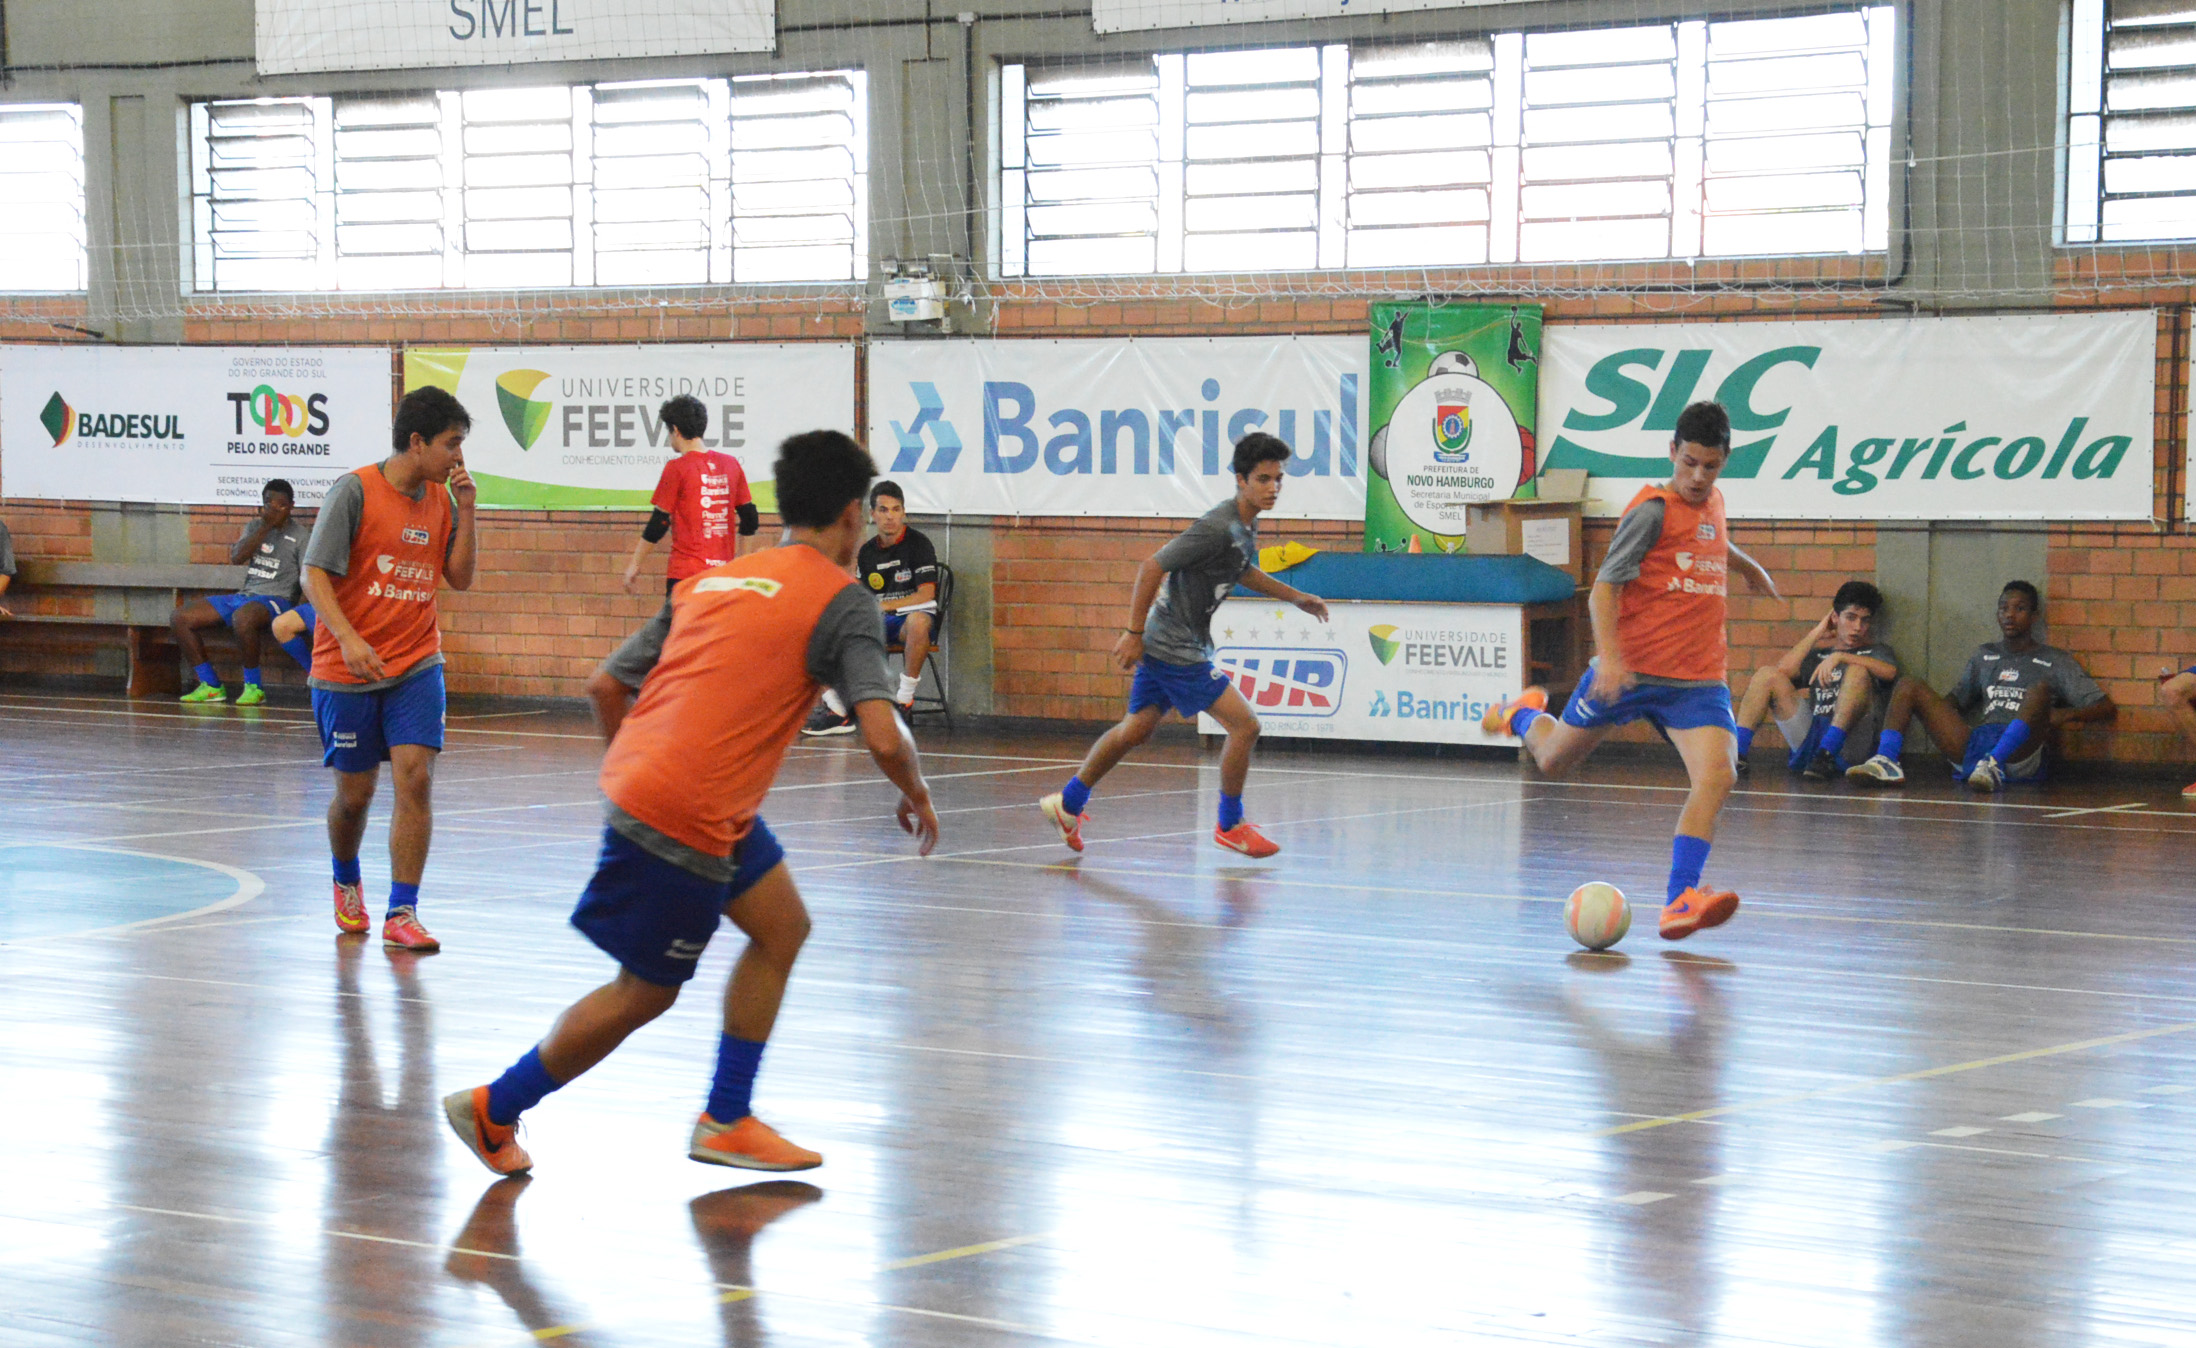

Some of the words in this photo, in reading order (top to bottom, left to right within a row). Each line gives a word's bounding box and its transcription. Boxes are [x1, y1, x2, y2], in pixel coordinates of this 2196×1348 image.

[450, 0, 574, 40] SMEL
[232, 357, 273, 367] GOVERNO
[275, 357, 288, 367] DO
[290, 357, 323, 367] ESTADO
[228, 368, 241, 378] DO
[243, 368, 257, 378] RIO
[259, 368, 294, 378] GRANDE
[296, 369, 309, 378] DO
[311, 369, 327, 379] SUL
[562, 377, 746, 398] UNIVERSIDADE
[1562, 345, 1822, 431] SLC
[227, 384, 330, 438] TODOS
[78, 413, 185, 439] BADESUL
[562, 404, 746, 448] FEEVE
[77, 441, 185, 451] DESENVOLVIMENTO
[227, 442, 255, 454] PELO
[259, 442, 279, 454] RIO
[282, 443, 330, 456] GRANDE
[562, 455, 635, 466] CONHECIMENTO
[636, 455, 662, 466] PARA
[1782, 417, 2133, 495] Agrícola
[1423, 465, 1468, 474] PREFEITURA
[1469, 466, 1479, 474] DE
[217, 477, 260, 486] SECRETARIA
[1407, 474, 1434, 487] NOVO
[1436, 475, 1495, 489] HAMBURGO
[216, 487, 260, 499] ECONÔMICO,
[1410, 490, 1451, 500] Secretaria
[1453, 491, 1491, 502] Municipal
[1413, 501, 1424, 509] de
[1438, 511, 1462, 521] SMEL
[1405, 630, 1507, 644] UNIVERSIDADE
[1405, 643, 1507, 669] FEEVALE
[1397, 690, 1507, 722] Banrisl
